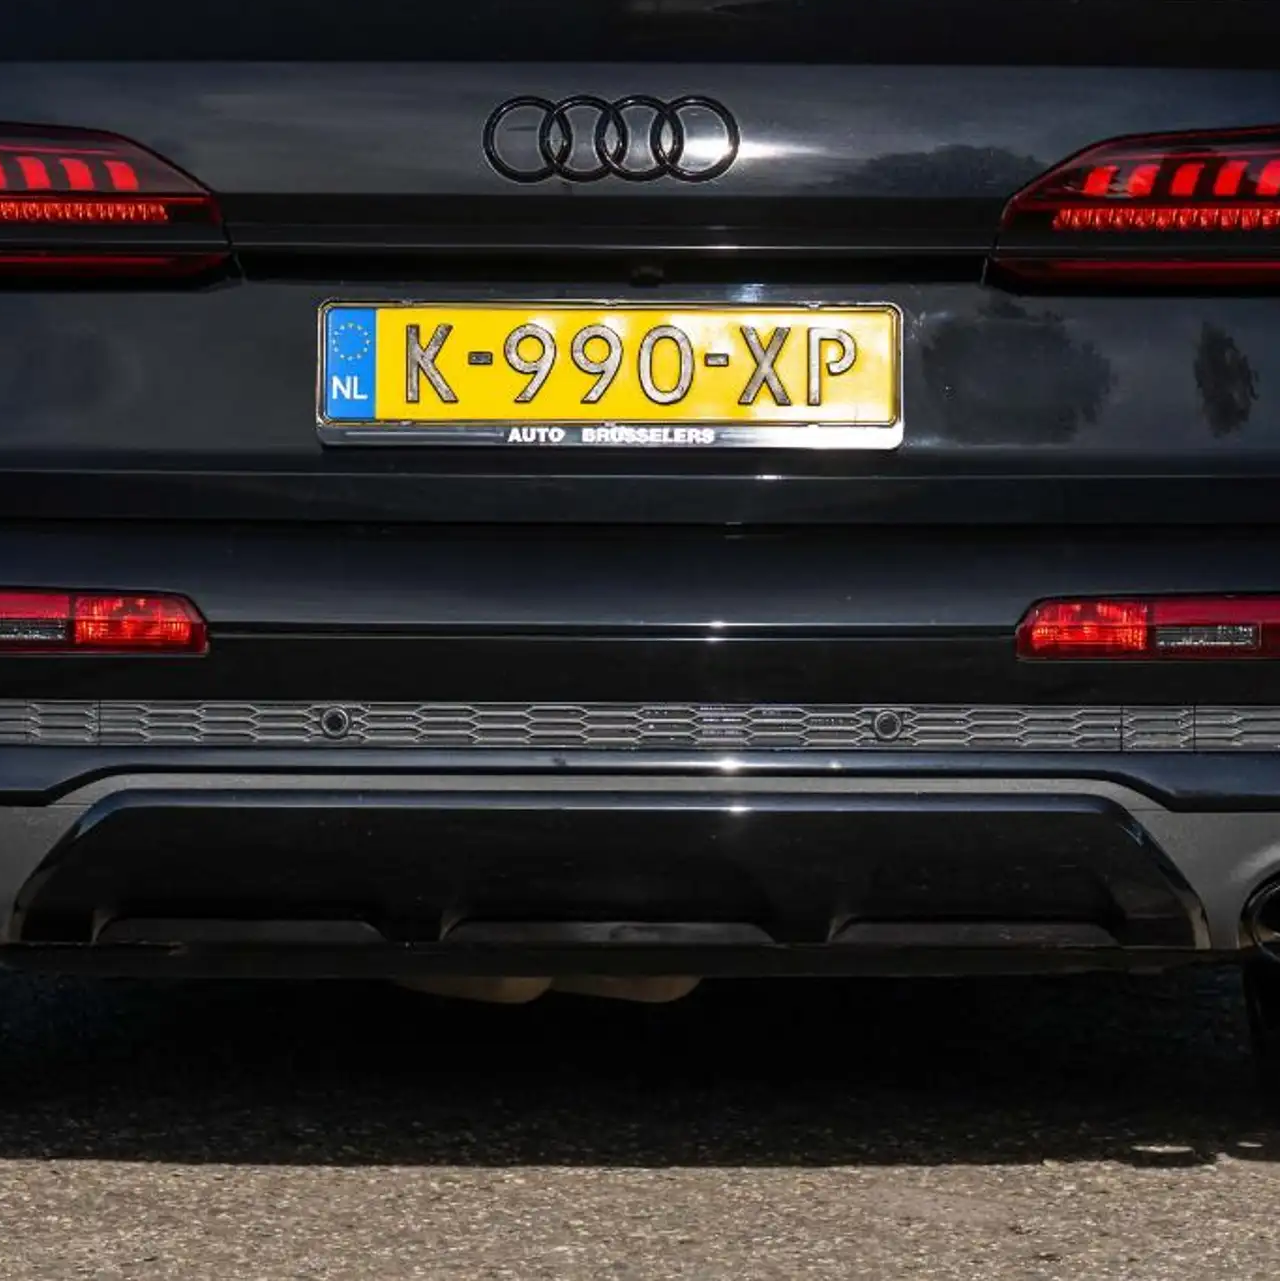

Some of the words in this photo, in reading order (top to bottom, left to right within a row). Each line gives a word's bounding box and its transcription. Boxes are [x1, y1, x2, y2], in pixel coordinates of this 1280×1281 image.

[405, 323, 857, 406] K-990-XP
[331, 375, 369, 400] NL
[508, 426, 566, 443] AUTO
[581, 426, 716, 445] BRUSSELERS
